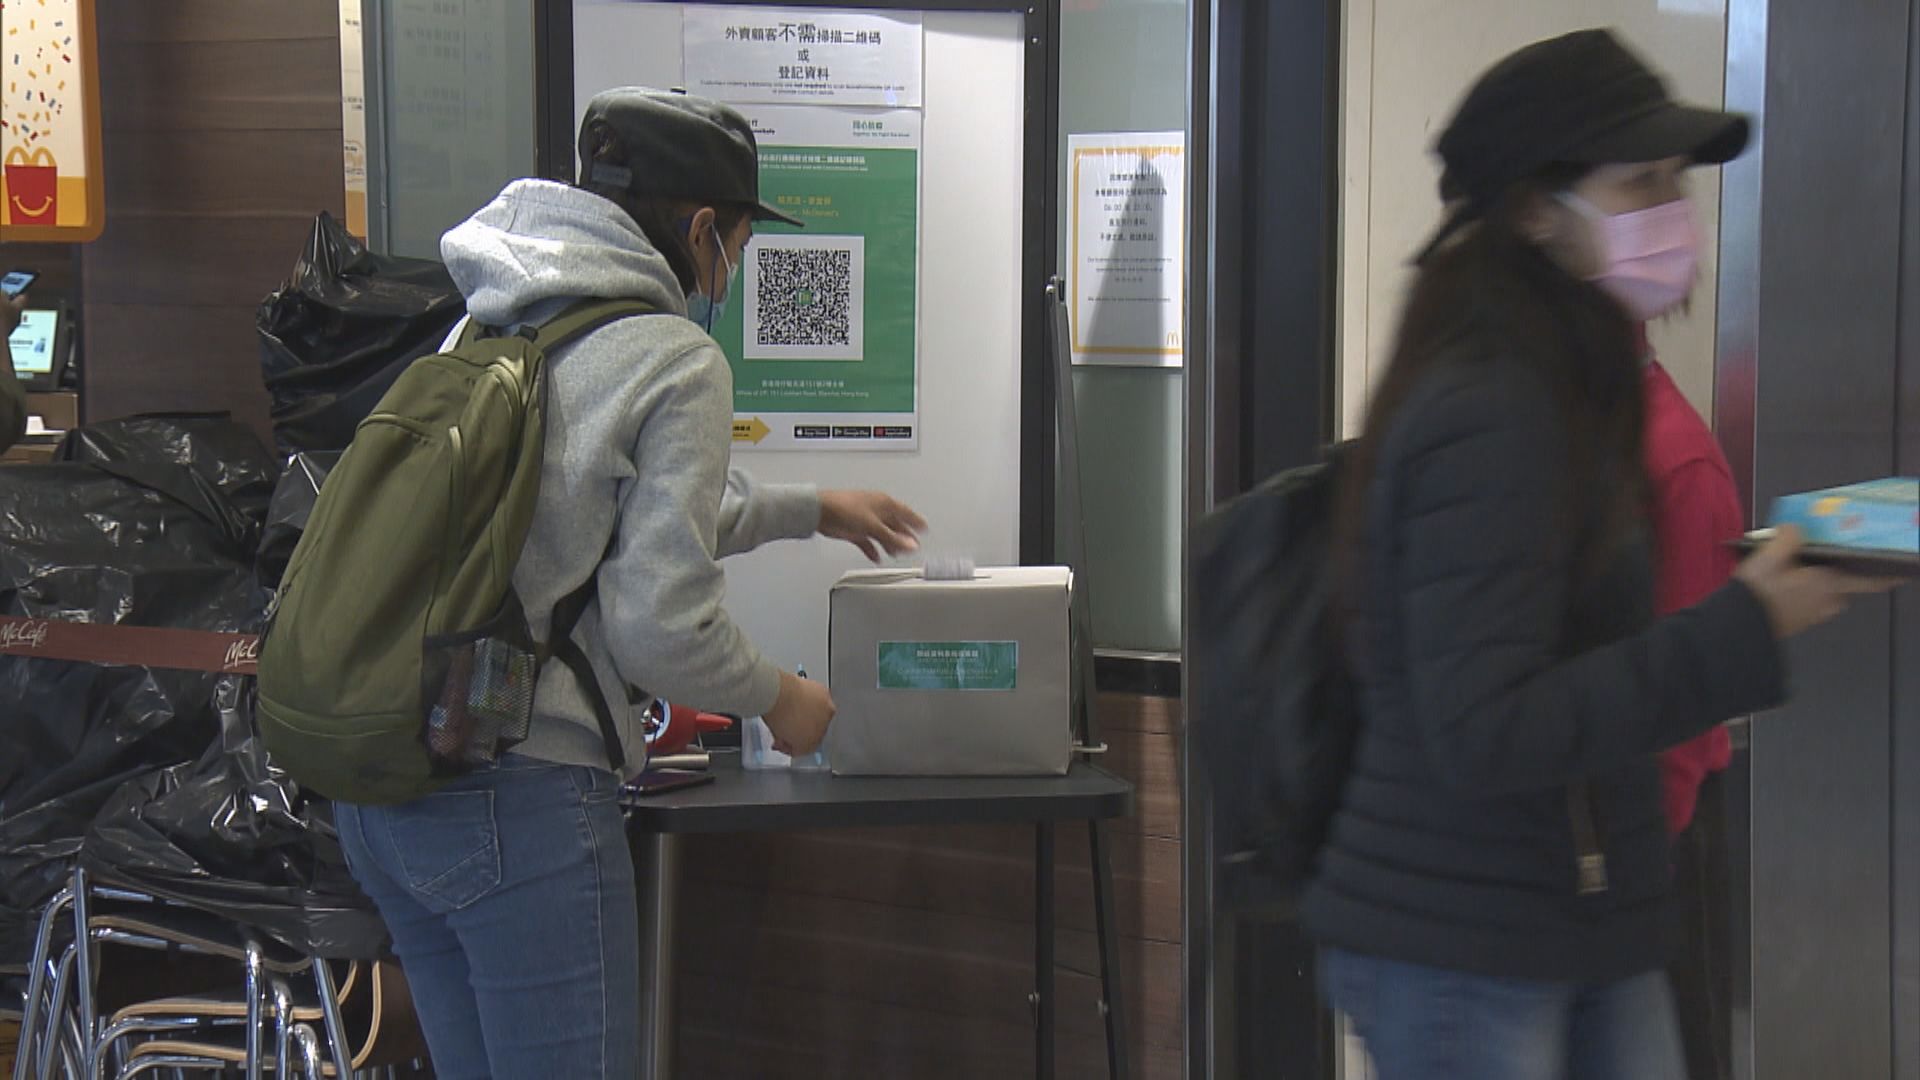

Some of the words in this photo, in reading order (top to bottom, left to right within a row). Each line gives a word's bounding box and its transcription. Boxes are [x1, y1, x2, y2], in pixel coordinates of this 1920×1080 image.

[797, 48, 810, 62] 或
[778, 66, 829, 80] 登記資料
[225, 639, 258, 667] McC
